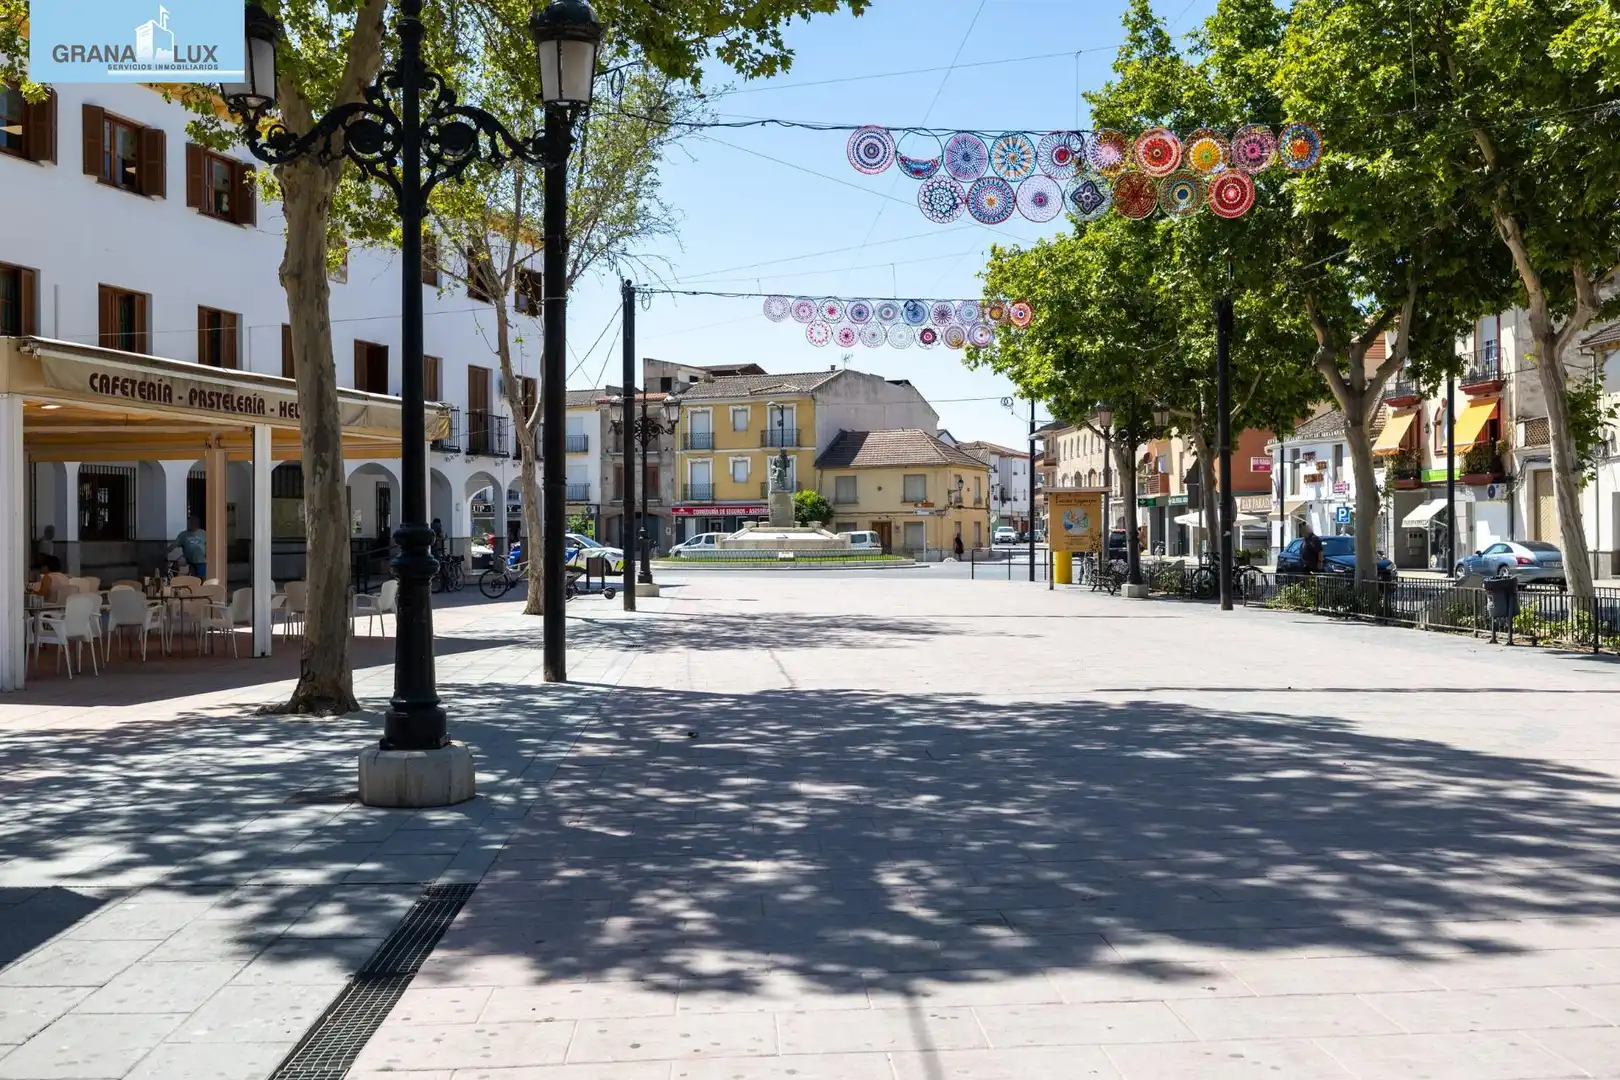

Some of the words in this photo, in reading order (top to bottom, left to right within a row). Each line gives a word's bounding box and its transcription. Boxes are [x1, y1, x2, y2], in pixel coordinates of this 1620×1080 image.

[89, 372, 173, 404] CAFETERÍA
[188, 387, 266, 415] PASTELERÍA
[1338, 508, 1348, 522] P
